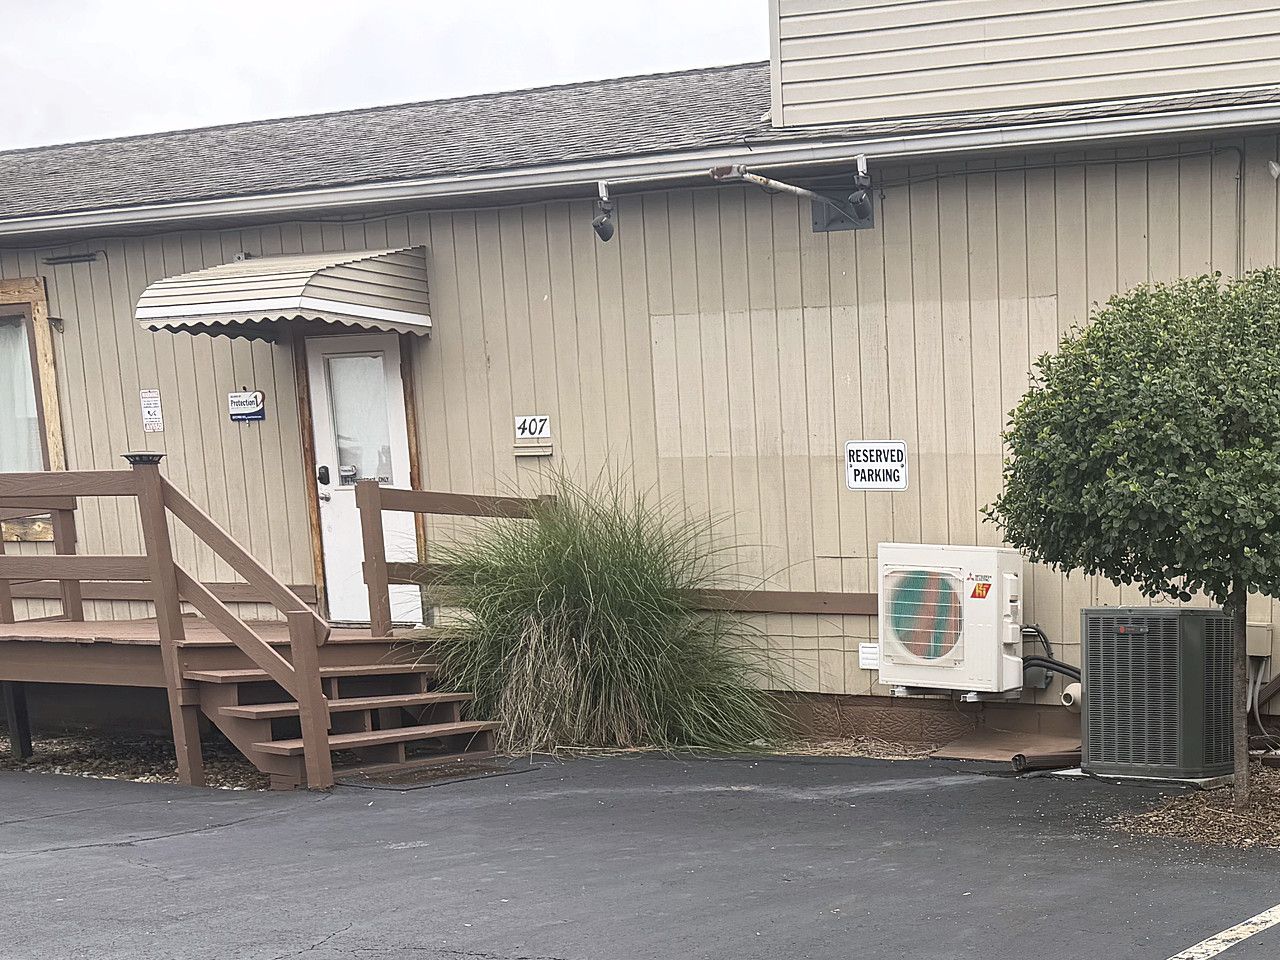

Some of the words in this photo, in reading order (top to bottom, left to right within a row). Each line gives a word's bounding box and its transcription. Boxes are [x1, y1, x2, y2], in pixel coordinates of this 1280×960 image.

[230, 399, 256, 407] Protection
[517, 418, 548, 436] 407
[848, 449, 904, 463] RESERVED
[853, 468, 900, 482] PARKING
